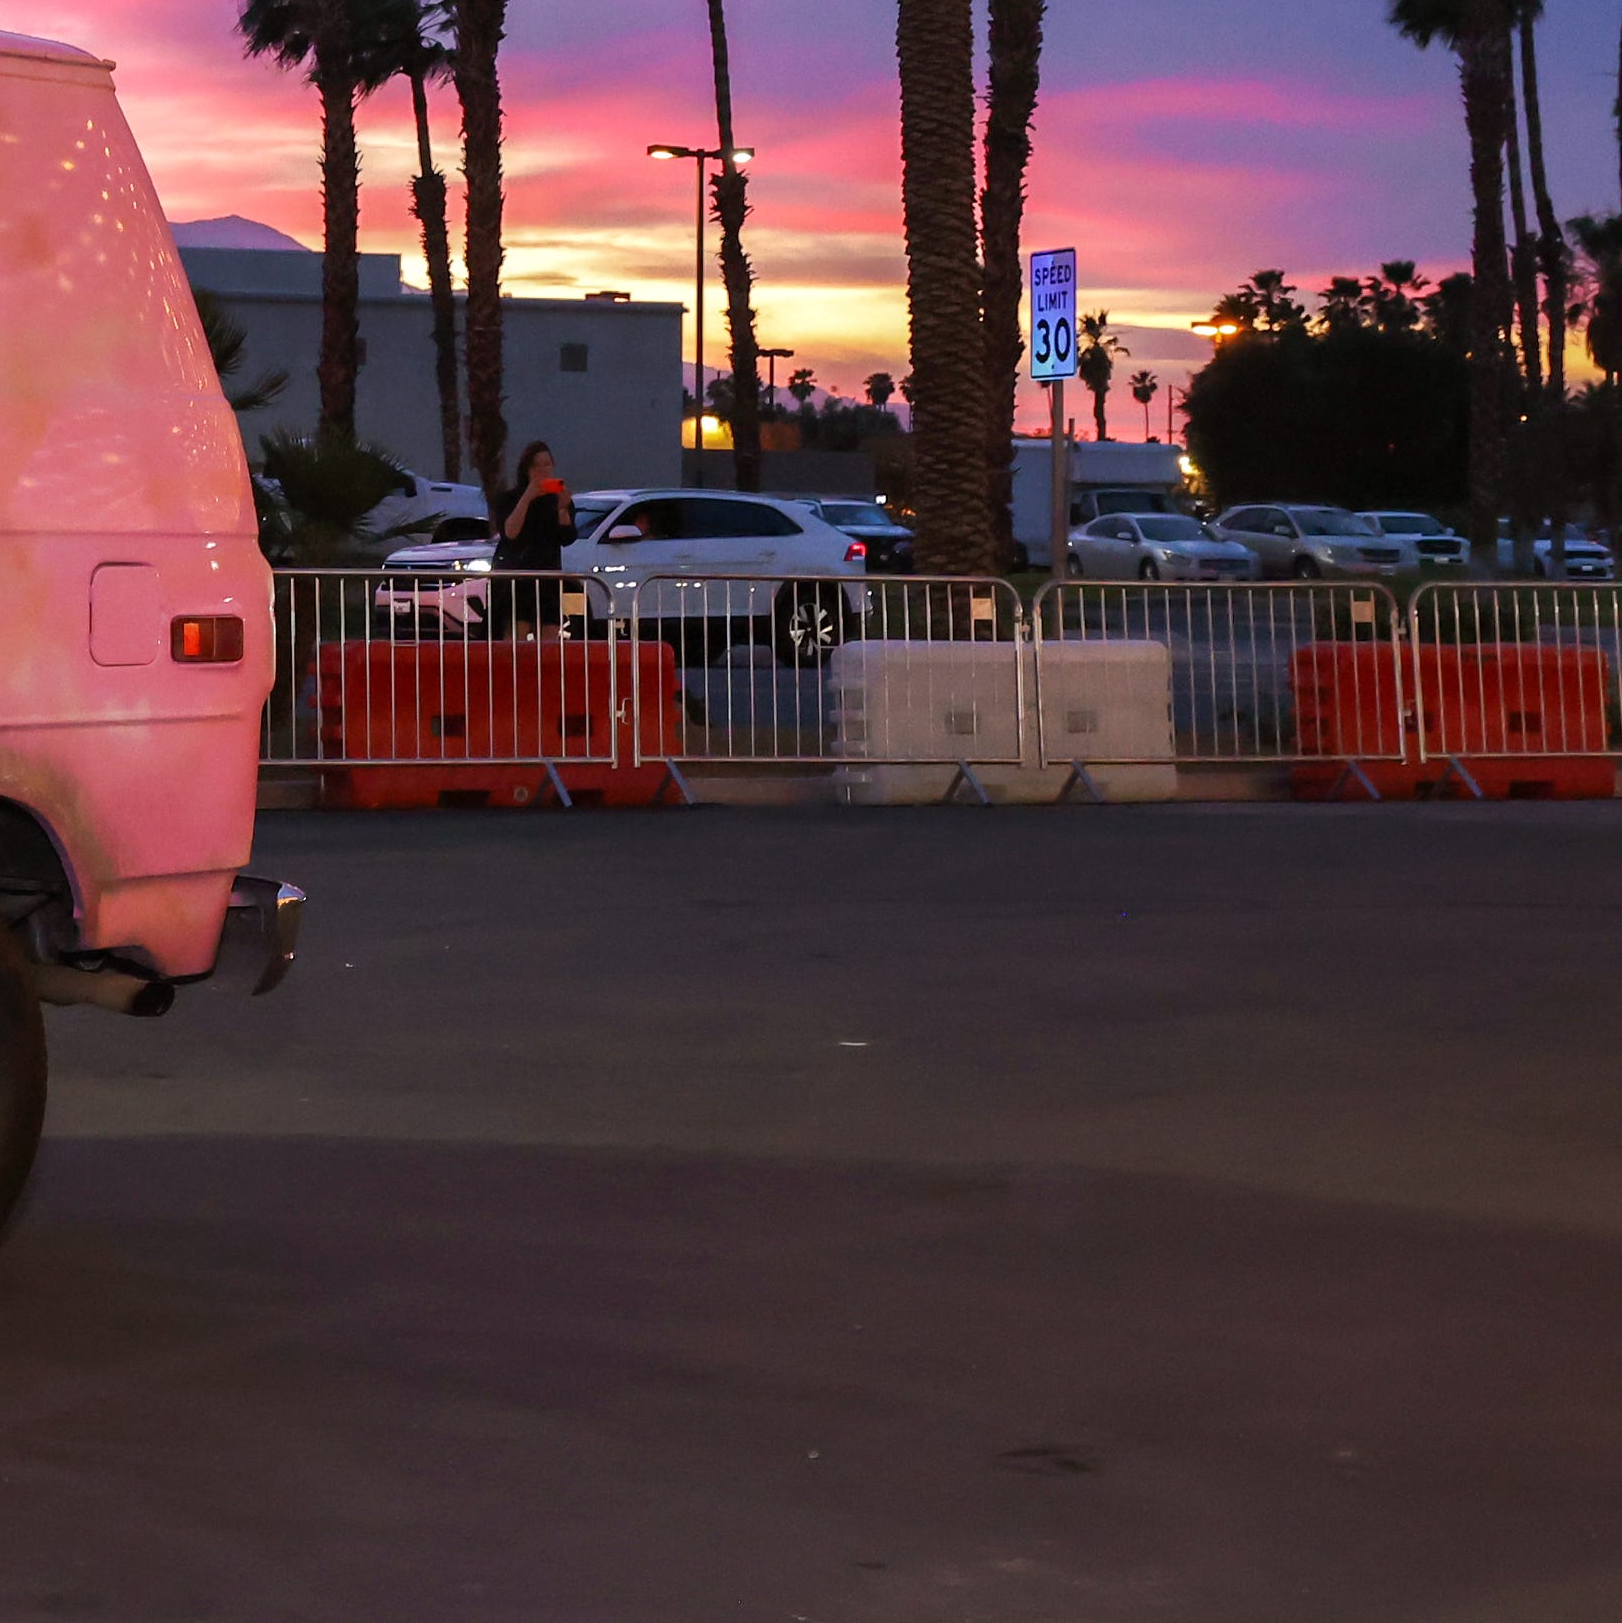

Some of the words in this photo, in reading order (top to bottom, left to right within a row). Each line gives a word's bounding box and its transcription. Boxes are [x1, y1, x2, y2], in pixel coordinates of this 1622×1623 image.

[1034, 264, 1072, 286] SPEED
[1037, 291, 1068, 312] LIMIT
[1035, 317, 1071, 364] 30
